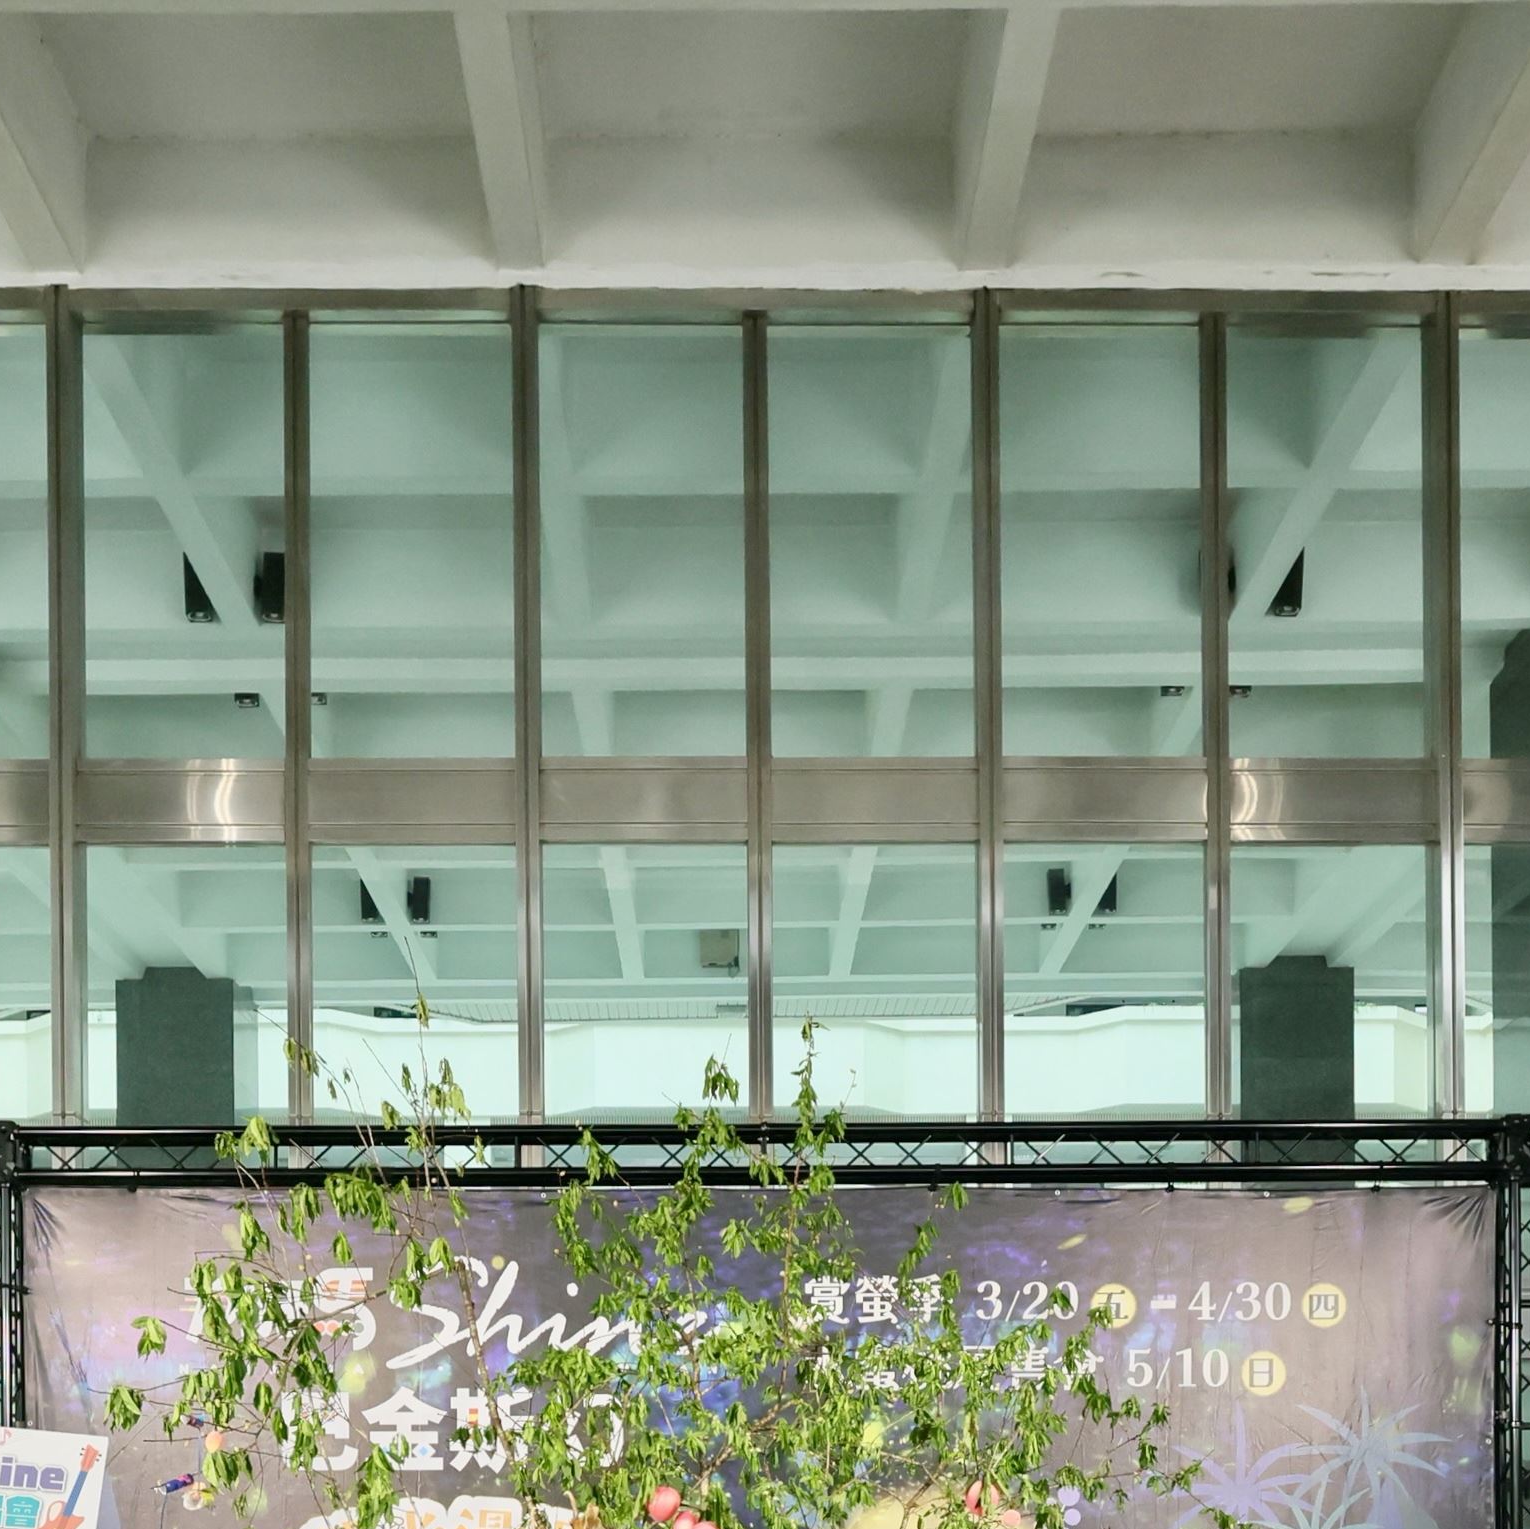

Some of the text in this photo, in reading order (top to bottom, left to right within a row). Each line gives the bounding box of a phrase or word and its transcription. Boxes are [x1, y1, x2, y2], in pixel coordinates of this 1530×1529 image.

[975, 1280, 1079, 1322] 3/20
[1187, 1281, 1292, 1322] 4/30
[1307, 1293, 1341, 1321] 四
[1126, 1347, 1230, 1389] 5/10
[1247, 1357, 1275, 1389] 日
